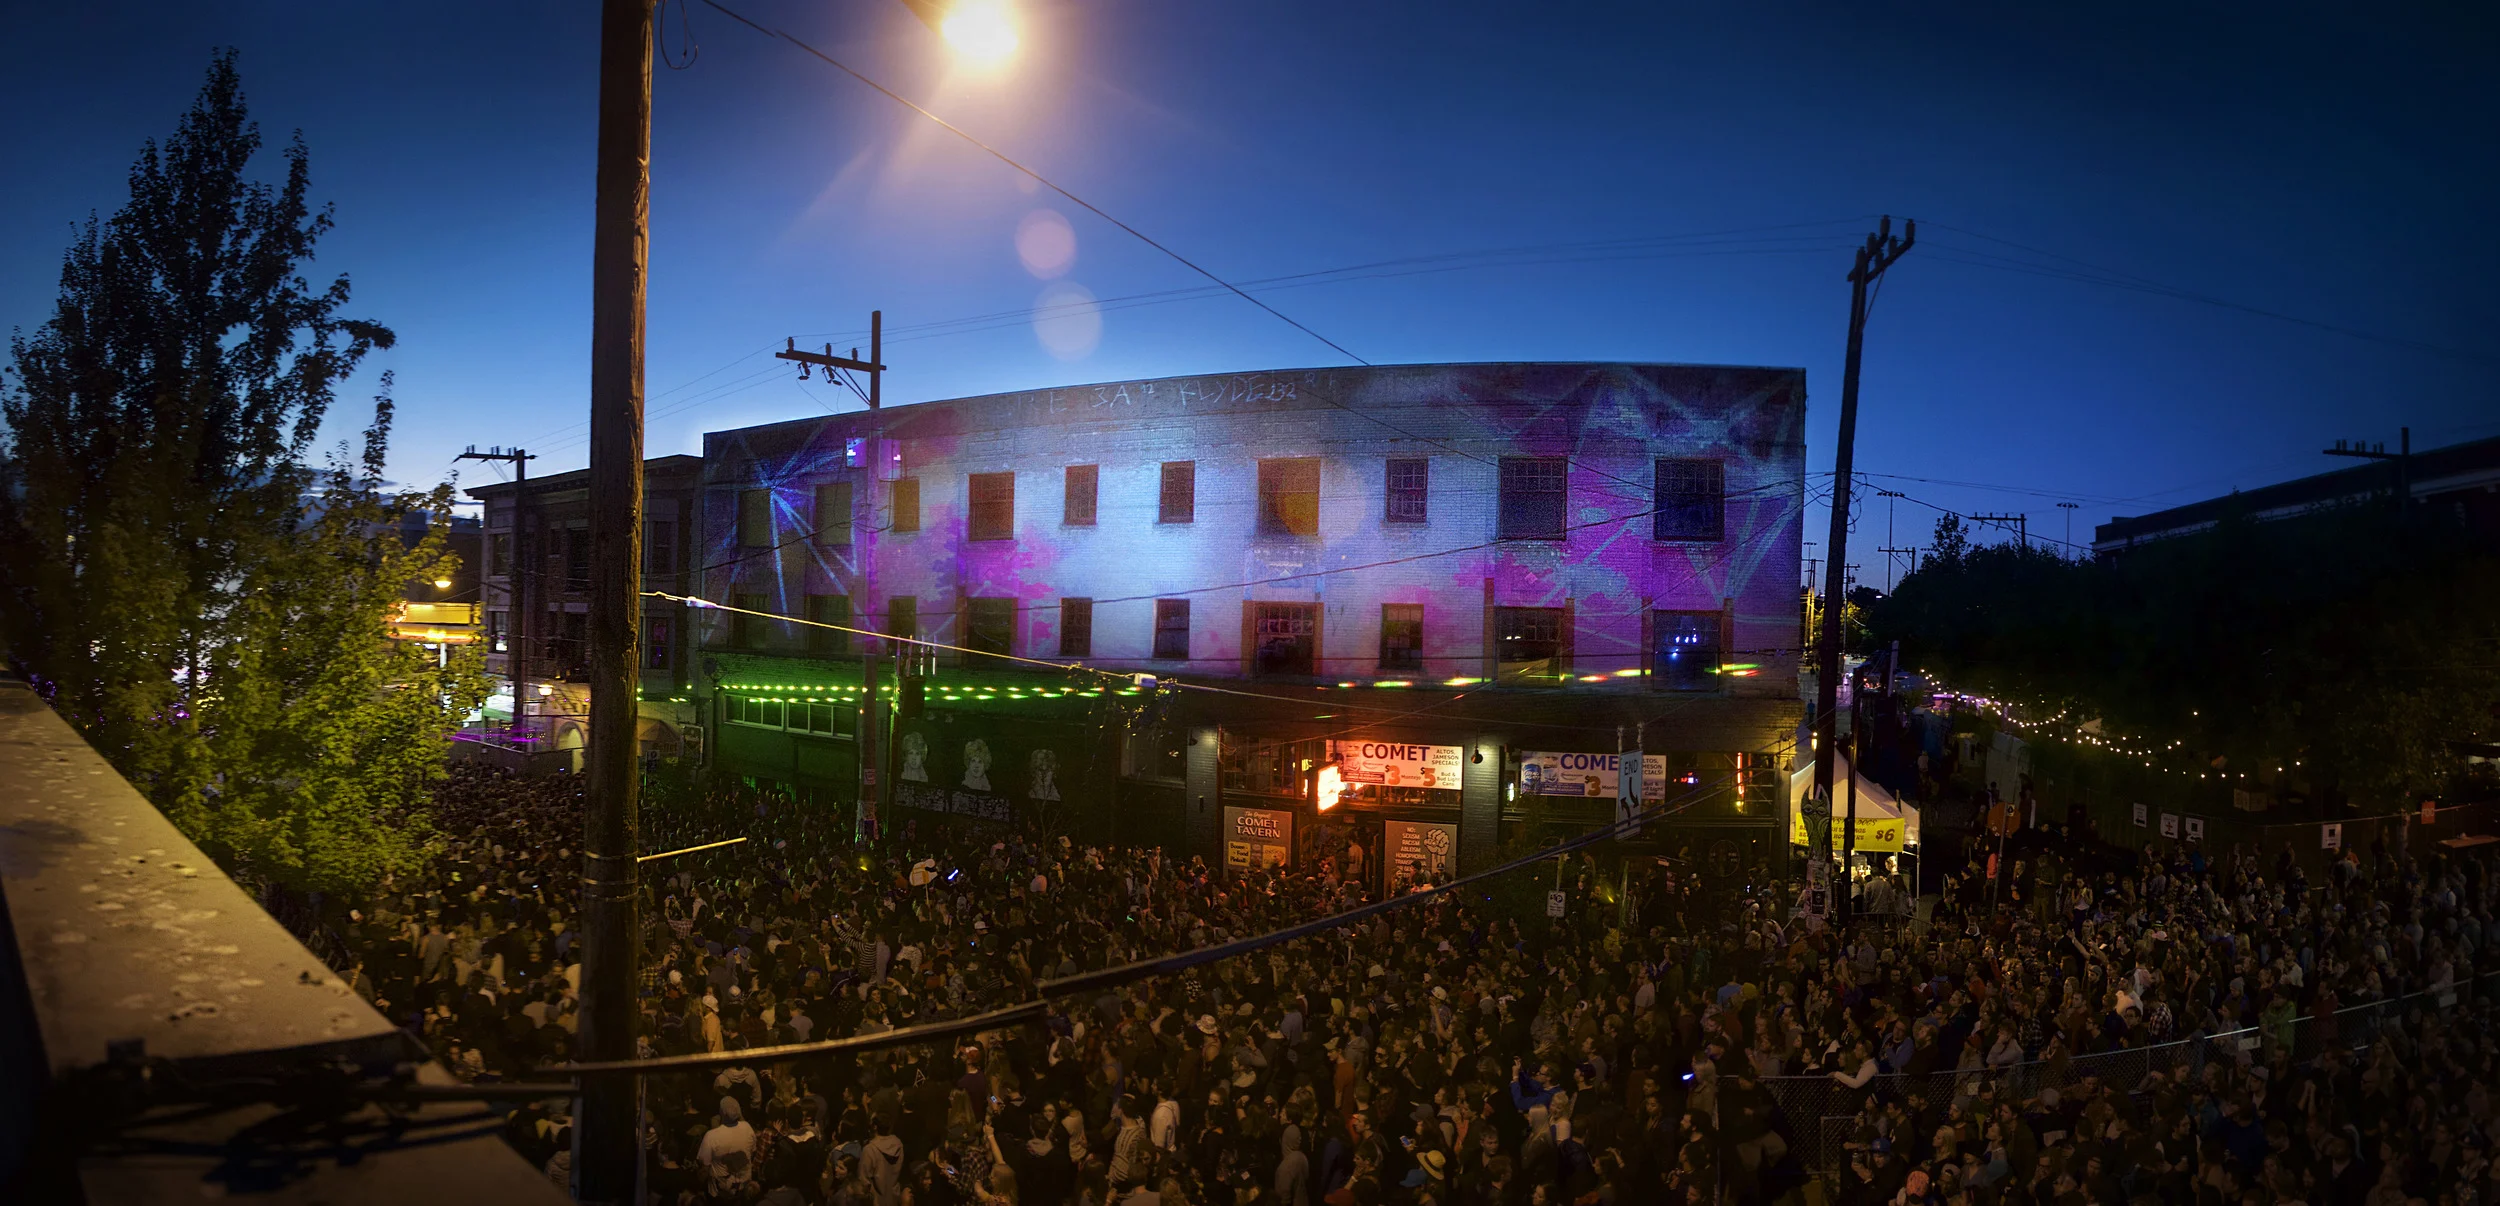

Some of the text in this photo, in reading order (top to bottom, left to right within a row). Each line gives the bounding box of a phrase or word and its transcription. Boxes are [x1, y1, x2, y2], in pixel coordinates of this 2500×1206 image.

[1362, 743, 1430, 761] COMET
[1560, 753, 1619, 771] COME
[1624, 759, 1639, 776] END
[1385, 764, 1401, 785] $3
[1420, 767, 1436, 787] $5
[1585, 775, 1601, 796] $3
[1238, 817, 1280, 828] COMET
[1236, 826, 1281, 838] TAVERN
[1875, 828, 1895, 842] $6
